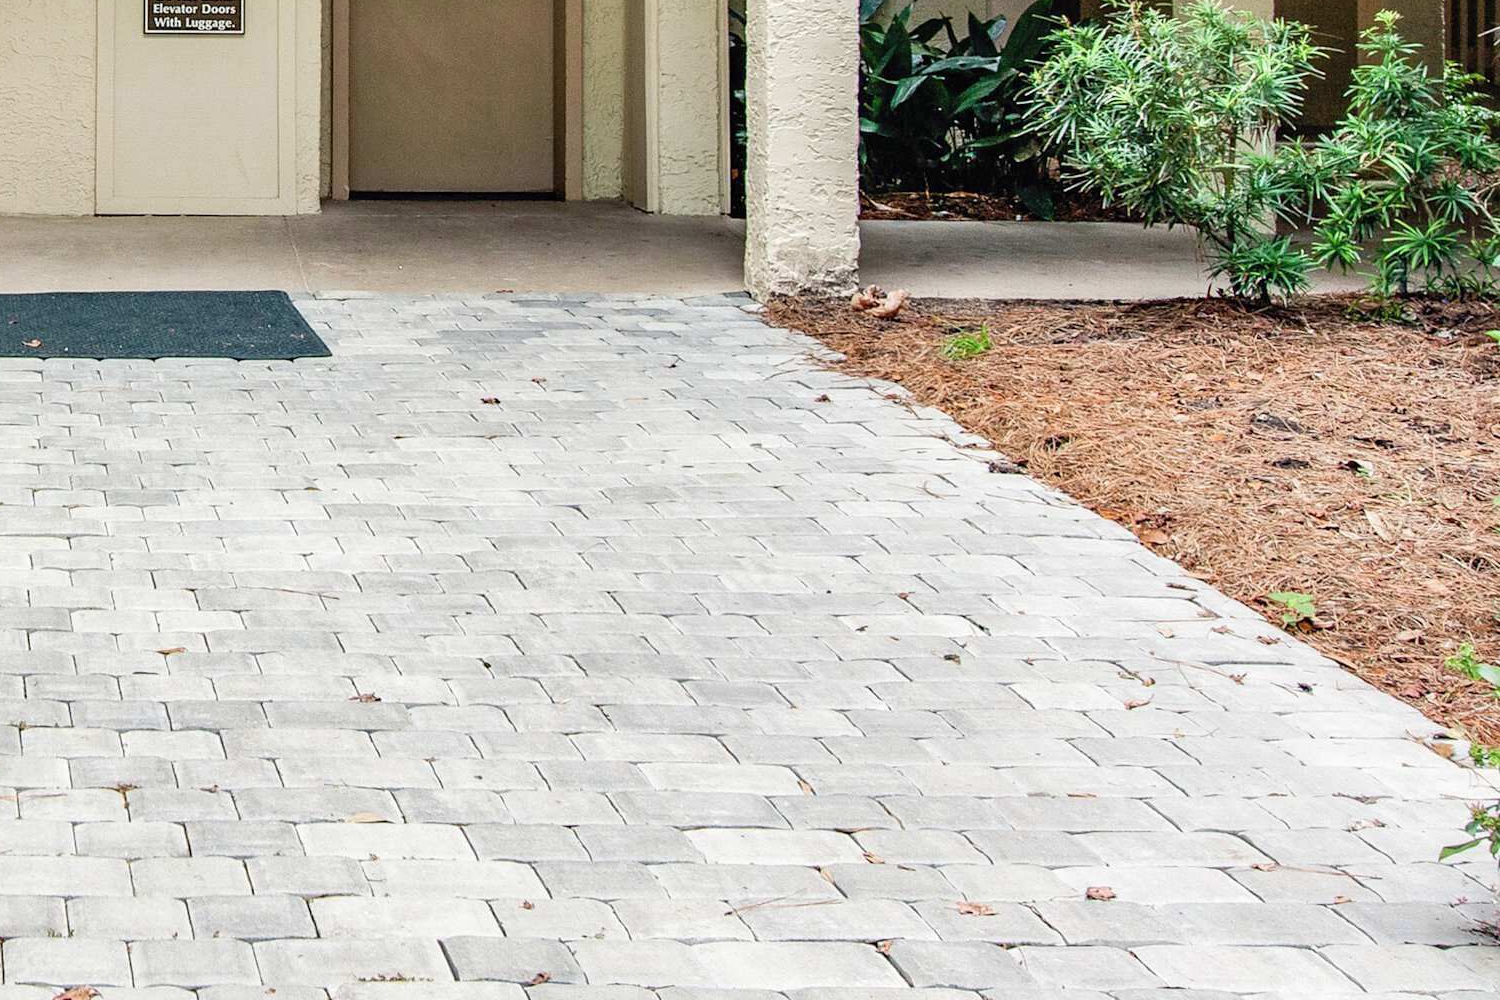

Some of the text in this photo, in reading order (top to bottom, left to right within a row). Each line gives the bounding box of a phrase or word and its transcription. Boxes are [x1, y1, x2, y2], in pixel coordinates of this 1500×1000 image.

[152, 3, 236, 14] Elevator Doors
[153, 17, 236, 31] With Luggage.
